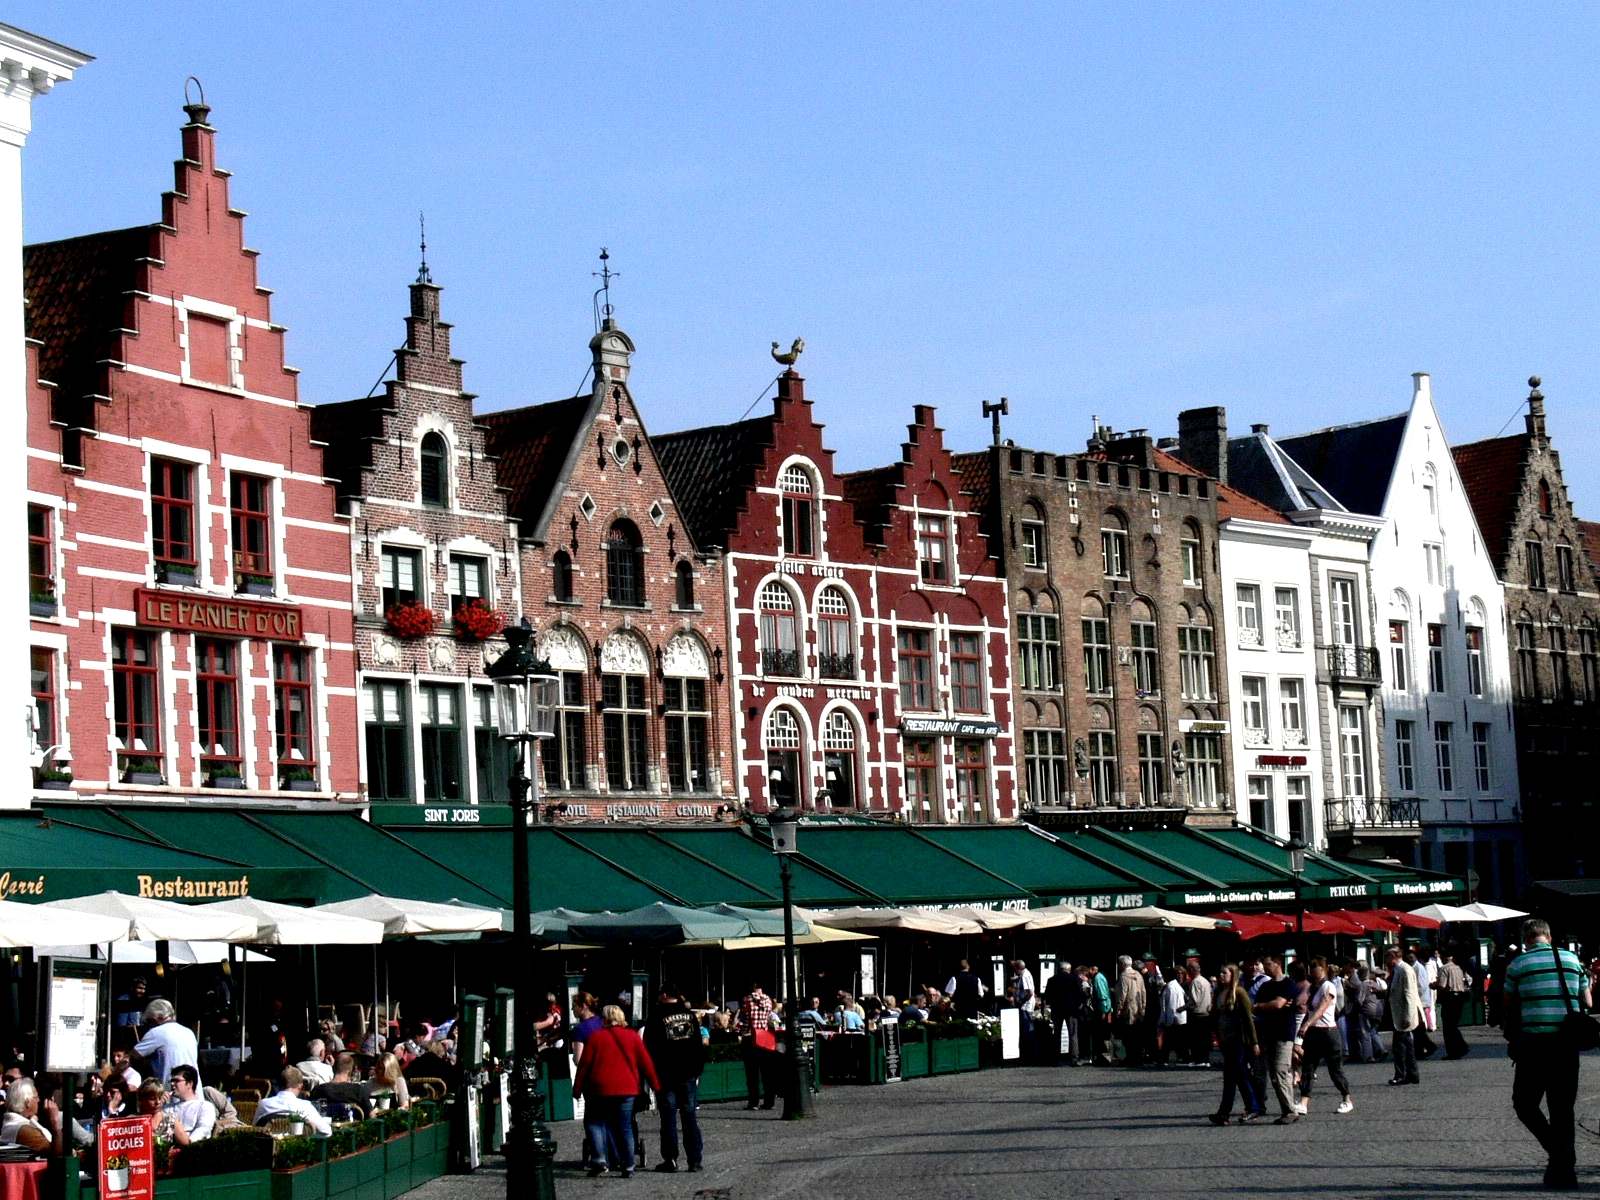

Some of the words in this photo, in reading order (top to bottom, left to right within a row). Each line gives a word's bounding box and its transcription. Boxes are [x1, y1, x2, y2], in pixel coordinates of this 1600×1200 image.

[775, 561, 804, 574] stella
[811, 565, 844, 577] artois
[146, 600, 173, 622] LE
[178, 600, 249, 631] PANIER
[256, 611, 298, 635] D'OR
[752, 683, 766, 697] de
[776, 684, 815, 698] gouden
[826, 687, 871, 700] meermin
[906, 720, 960, 732] RESTAURANT
[424, 809, 449, 822] SINT
[451, 809, 480, 822] JORIS
[607, 804, 661, 816] RESTAURANT
[676, 804, 713, 816] CENTRAL
[0, 871, 45, 899] Carré
[137, 874, 249, 897] Restaurant
[1329, 886, 1348, 897] PETIT
[1349, 885, 1367, 896] CAFE
[1429, 881, 1453, 892] 1900
[1002, 899, 1030, 911] HOTEL
[1091, 896, 1111, 909] DES
[1115, 894, 1143, 907] ARTS
[108, 1137, 144, 1151] LOCALES
